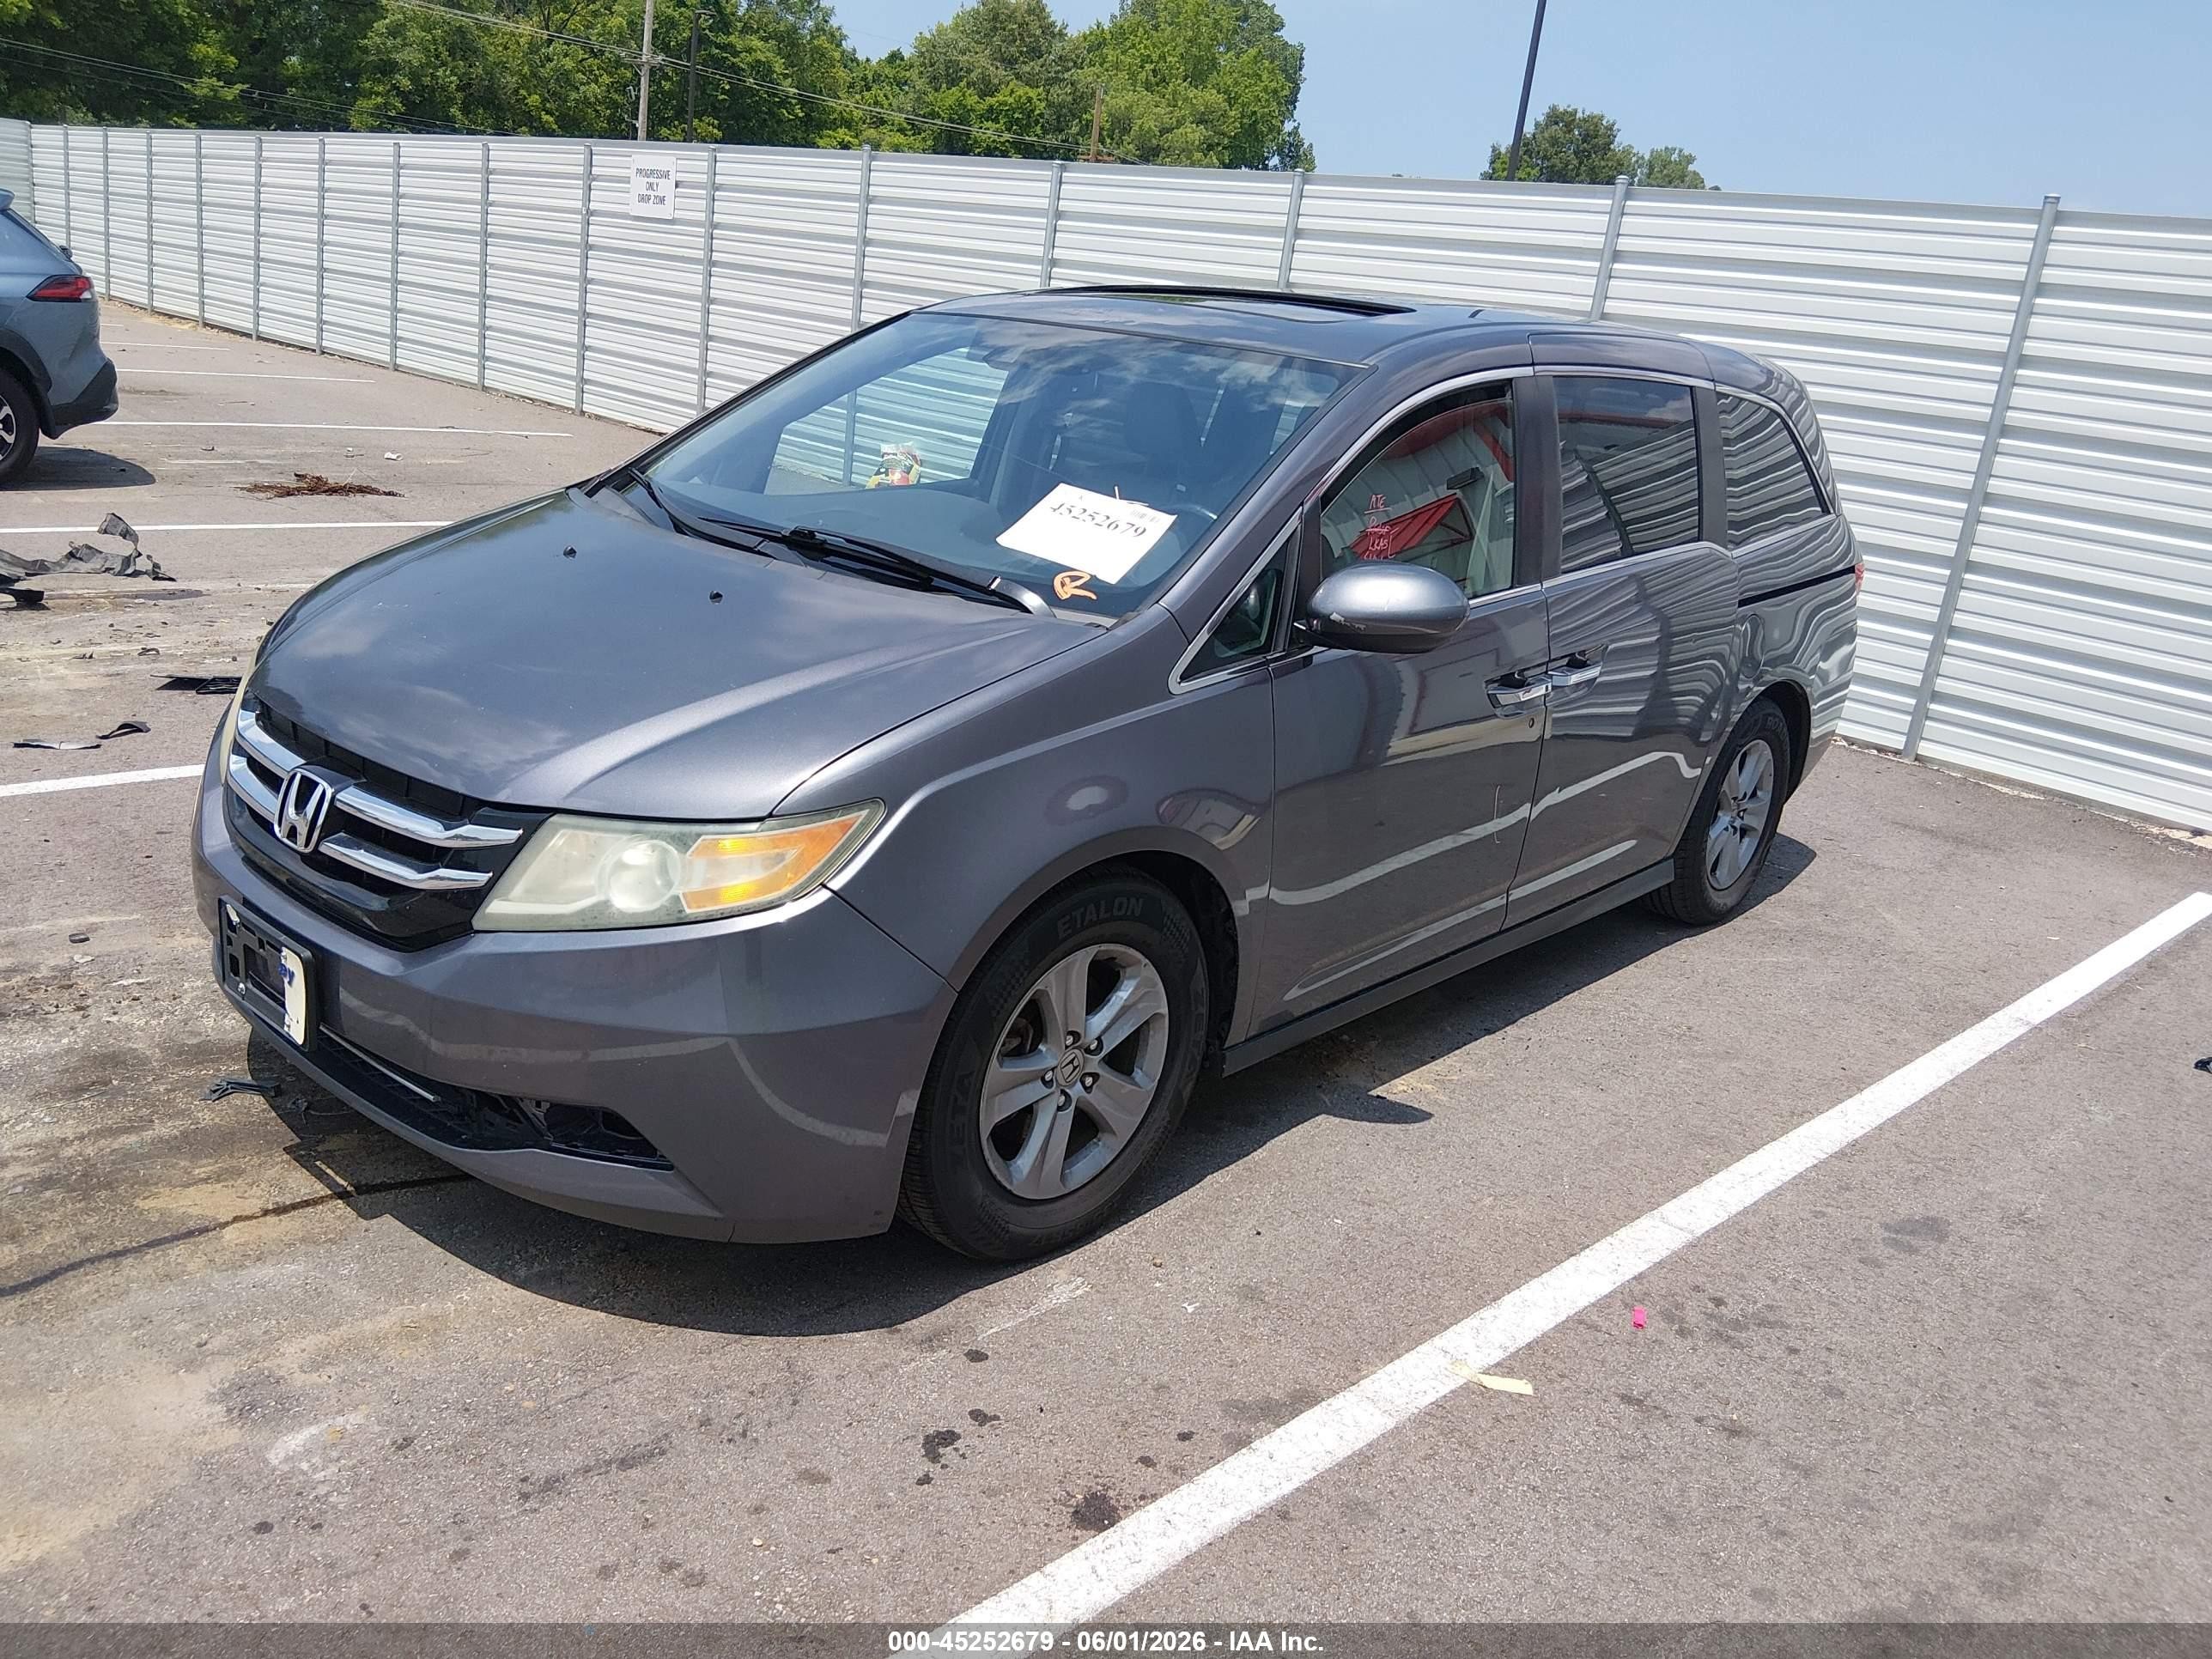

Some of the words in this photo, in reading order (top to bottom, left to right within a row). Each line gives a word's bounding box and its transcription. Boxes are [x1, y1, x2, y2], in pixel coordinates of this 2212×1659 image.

[635, 167, 671, 179] PROGRESSIVE
[646, 180, 659, 192] ONLY
[637, 193, 652, 204] DROP
[653, 195, 666, 205] ZONE
[1049, 502, 1147, 538] 45252679
[1057, 896, 1146, 939] ETALON
